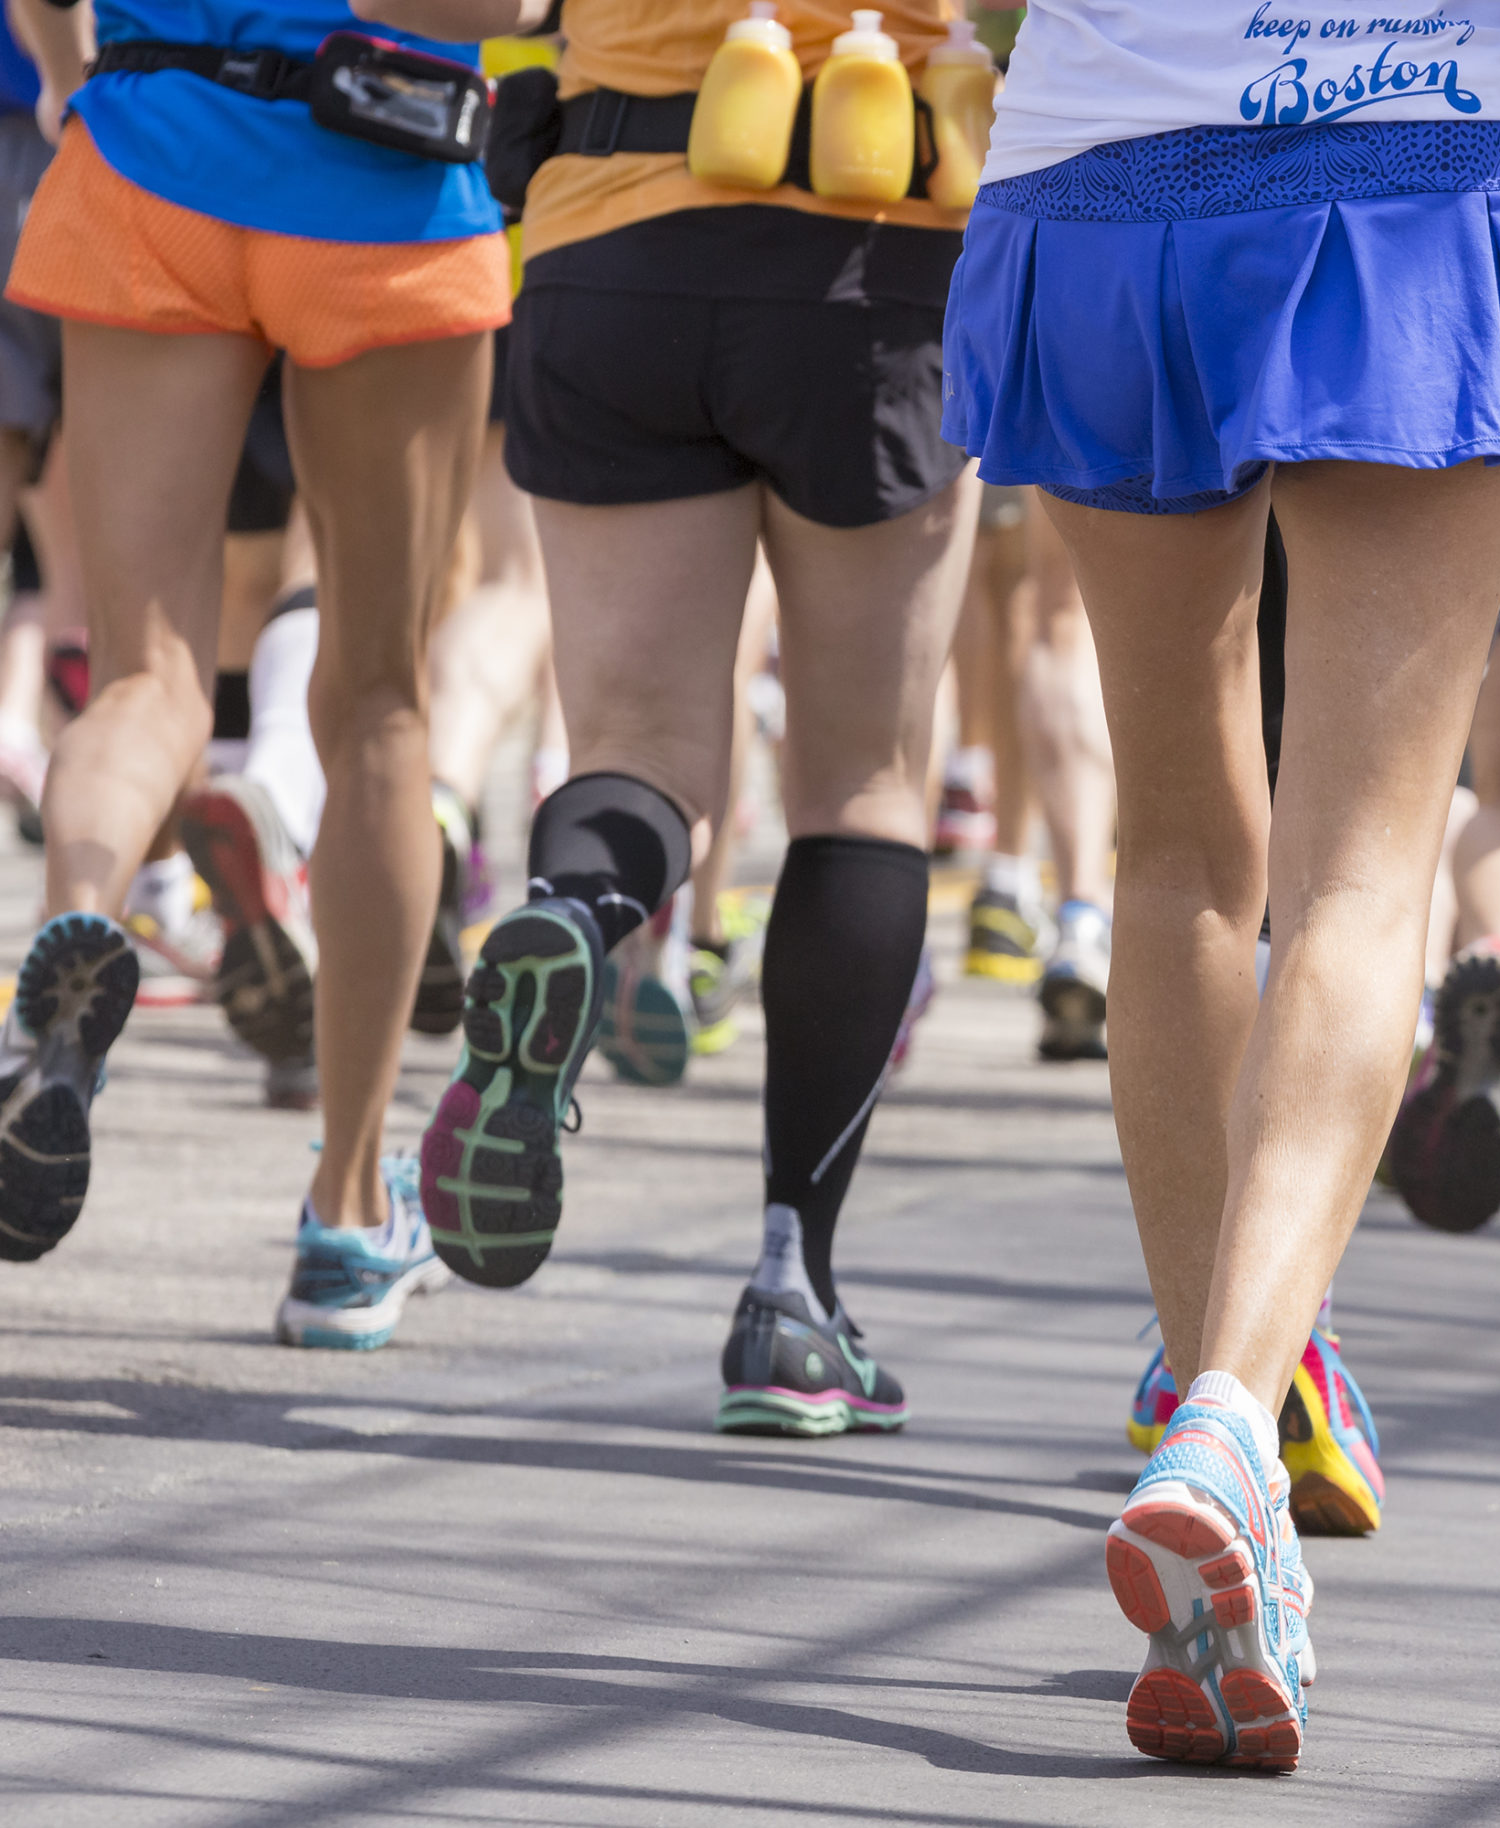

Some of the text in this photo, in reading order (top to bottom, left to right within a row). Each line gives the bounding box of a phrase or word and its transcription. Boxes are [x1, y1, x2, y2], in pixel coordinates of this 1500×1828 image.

[1244, 1, 1311, 55] keep
[1320, 17, 1360, 39] on
[1239, 41, 1482, 125] Boston
